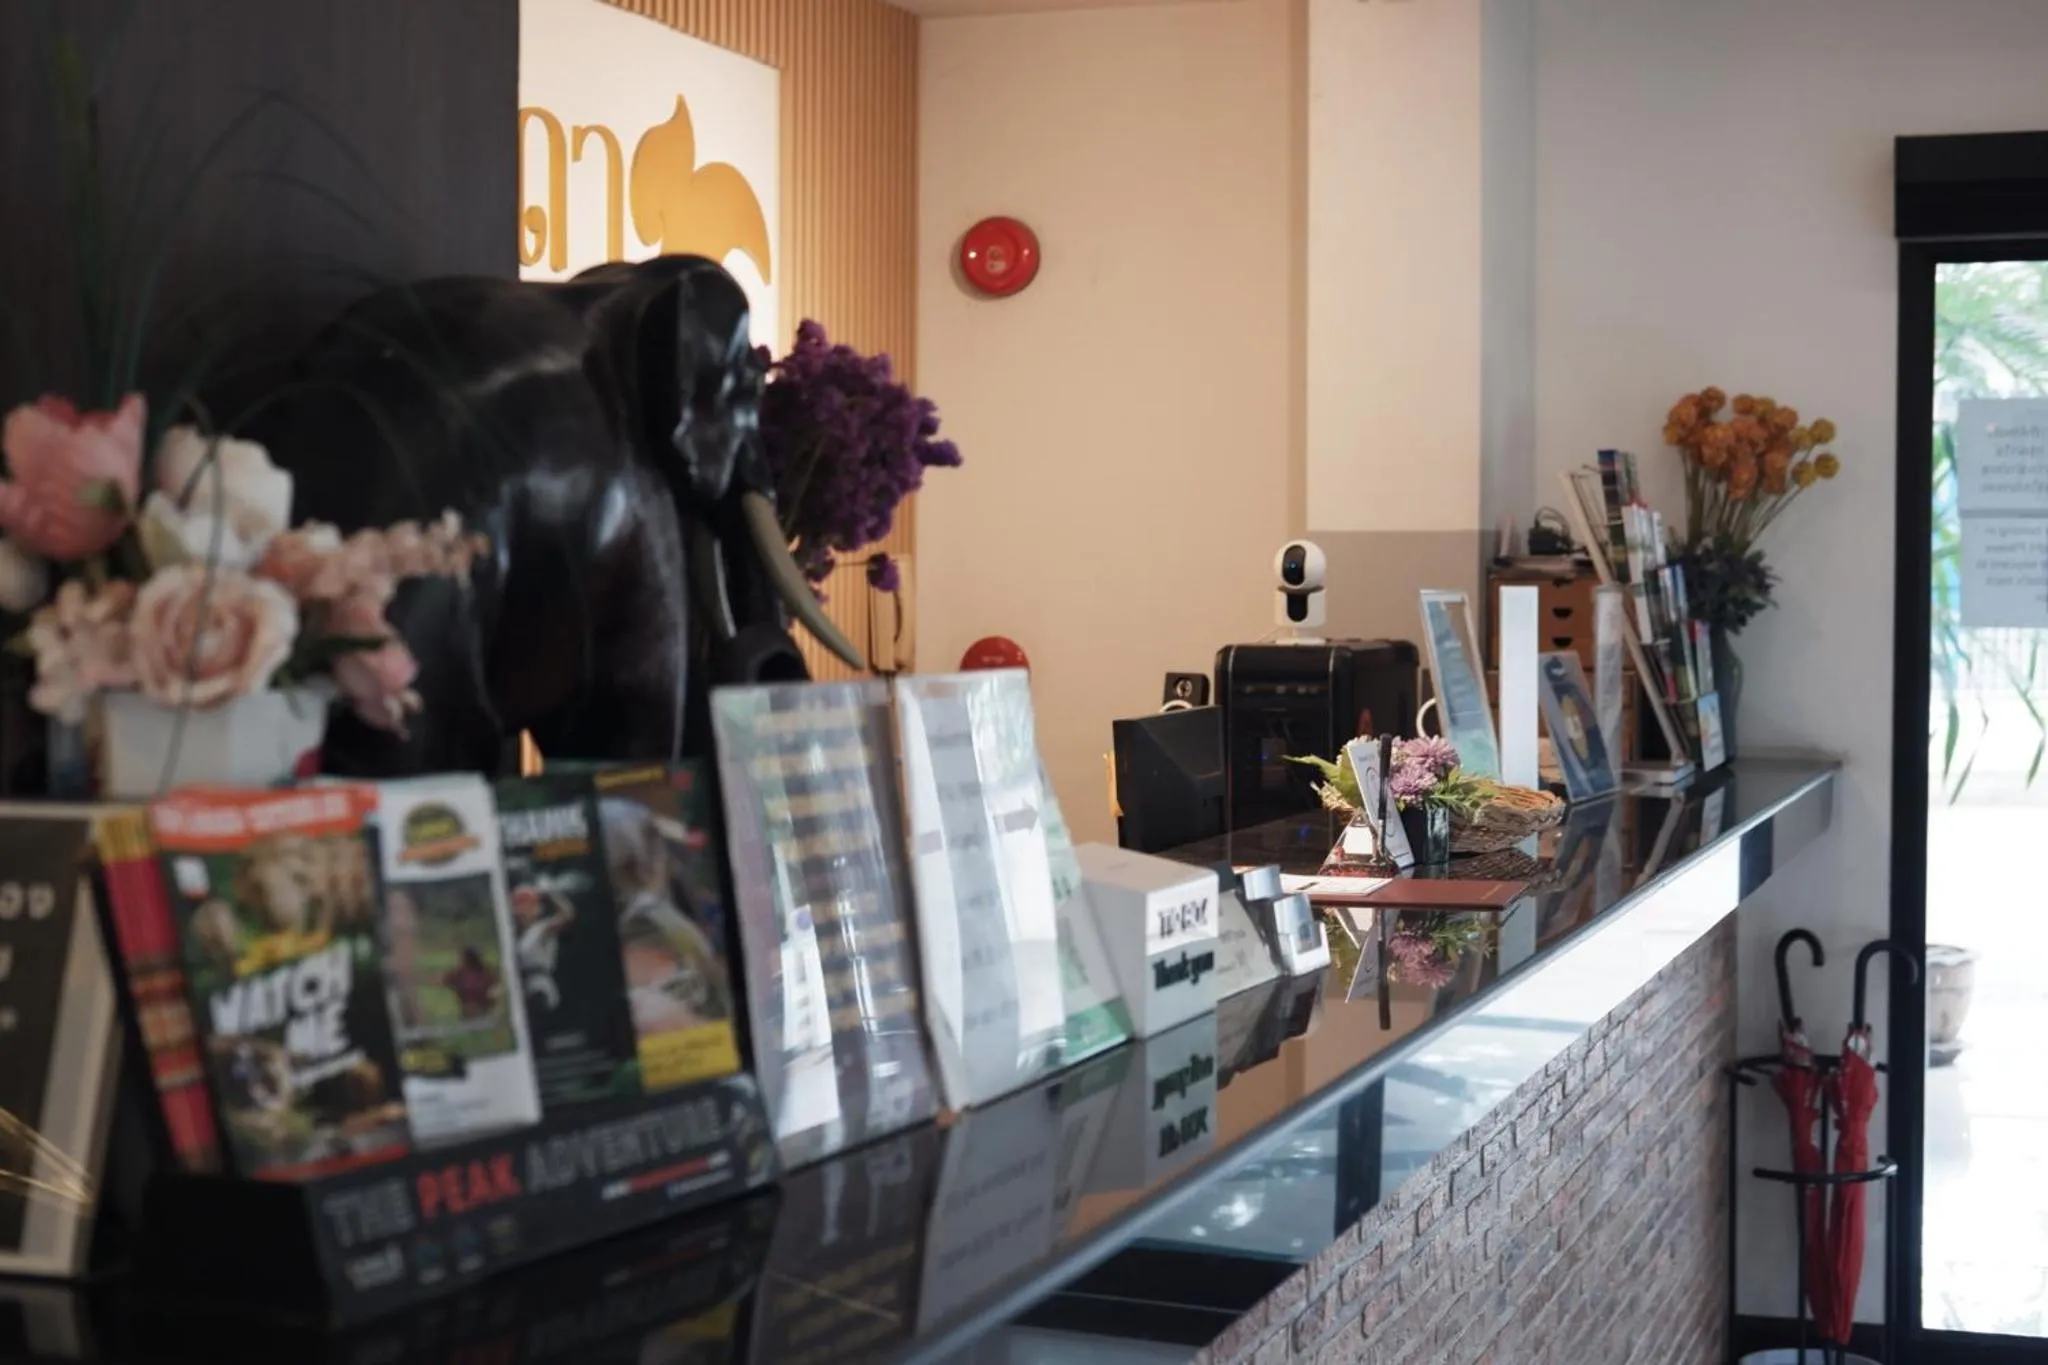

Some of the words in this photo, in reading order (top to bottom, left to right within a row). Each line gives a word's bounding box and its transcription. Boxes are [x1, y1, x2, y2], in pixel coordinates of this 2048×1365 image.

[207, 938, 354, 1036] WATCH
[321, 1176, 415, 1249] THE
[415, 1151, 524, 1222] PEAK
[524, 1095, 725, 1194] ADVENTURE
